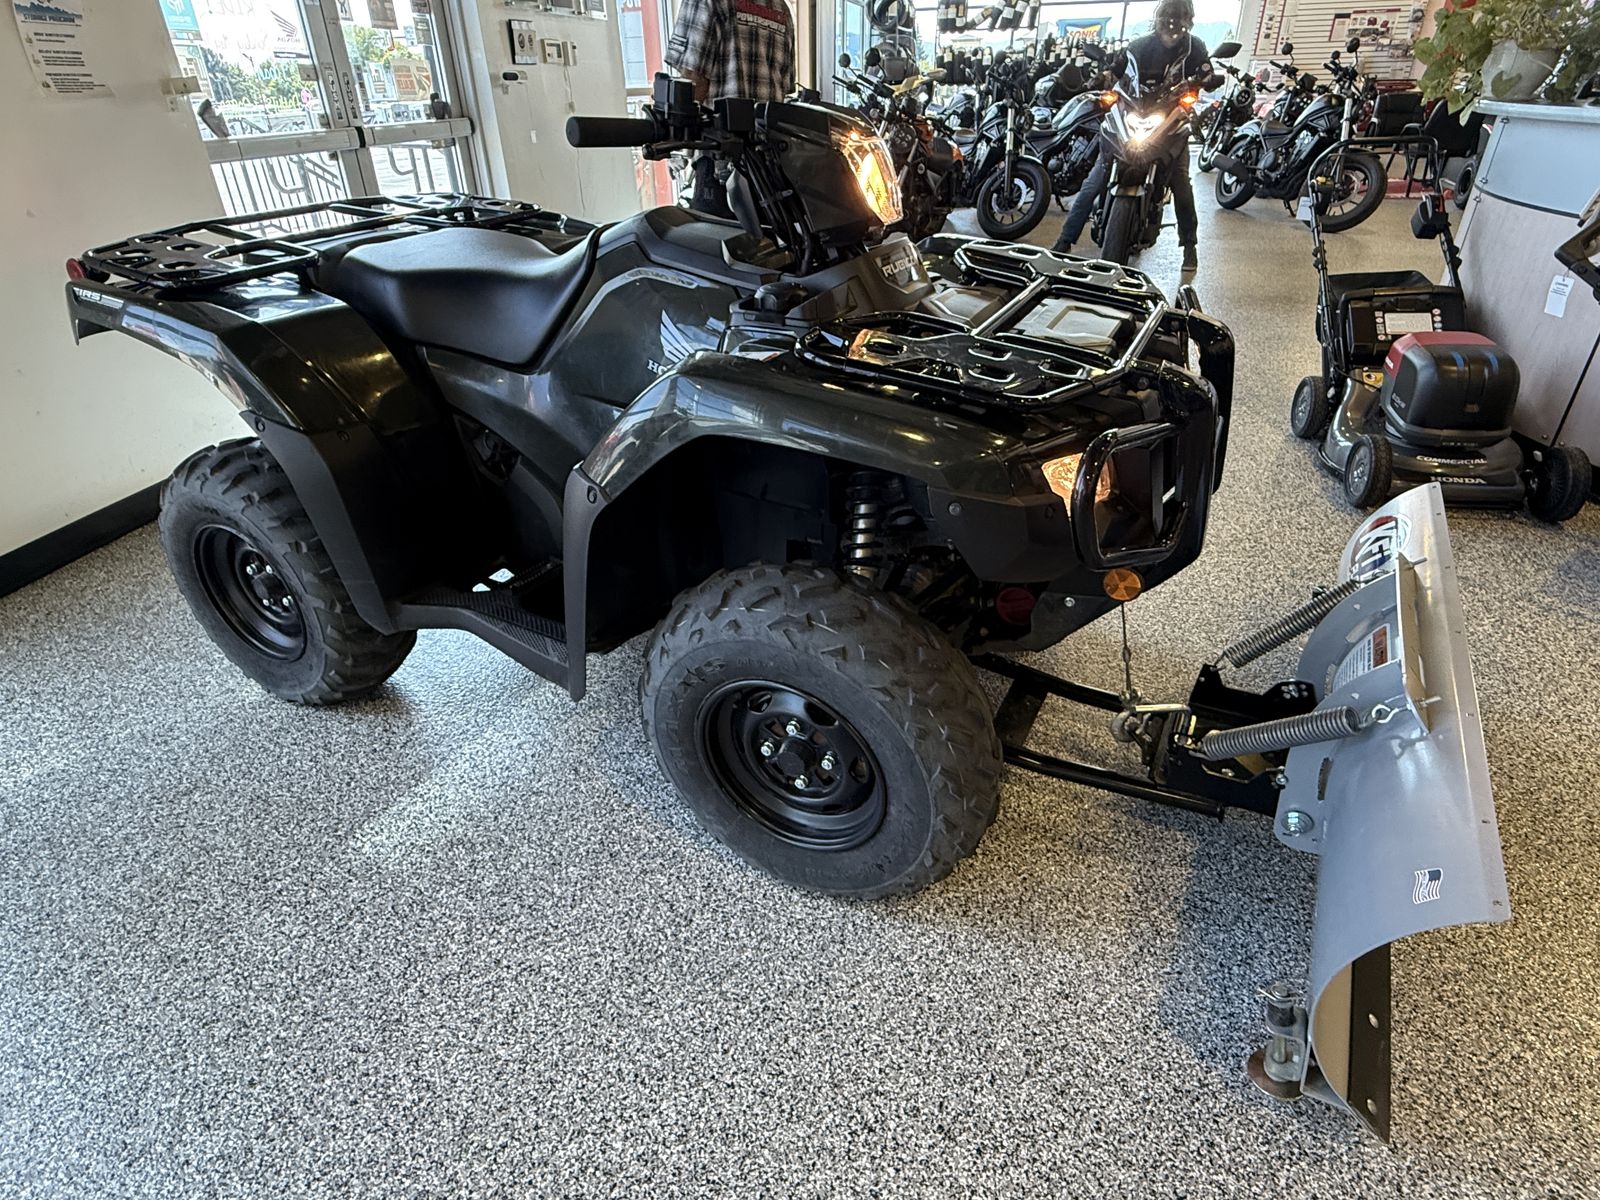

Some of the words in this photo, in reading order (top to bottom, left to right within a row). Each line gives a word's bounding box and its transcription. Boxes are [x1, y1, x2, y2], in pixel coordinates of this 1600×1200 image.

[736, 12, 786, 33] POWERSPORTS
[1069, 30, 1097, 38] SONIC
[1416, 455, 1488, 465] COMMERCIAL
[1430, 475, 1488, 485] HONDA
